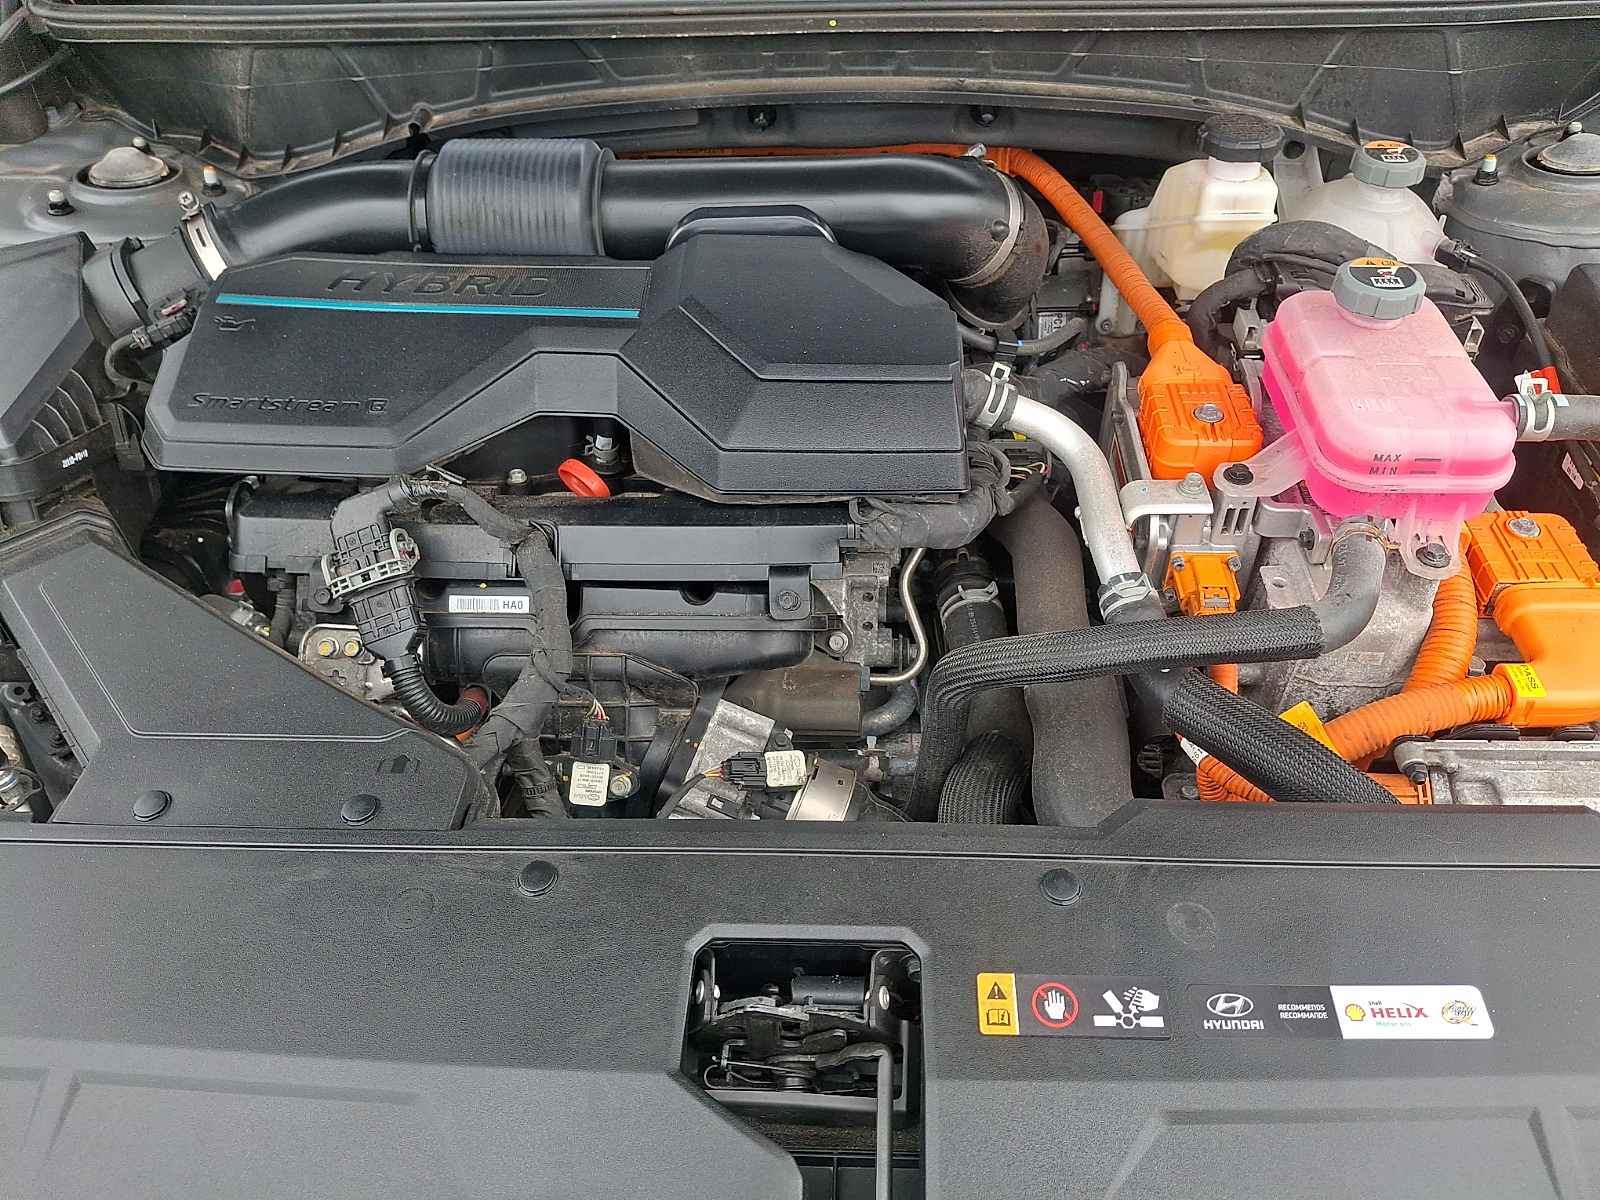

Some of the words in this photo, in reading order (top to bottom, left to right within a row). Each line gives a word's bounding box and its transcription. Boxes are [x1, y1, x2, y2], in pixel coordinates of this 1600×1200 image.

[326, 271, 555, 298] HYBRID
[188, 393, 361, 413] Smartstream
[1373, 453, 1402, 462] MAX
[1369, 466, 1398, 475] MIN
[1521, 664, 1539, 689] PASS
[1278, 1003, 1326, 1011] RECOMMENDS
[1370, 1006, 1430, 1018] HELIX
[1280, 1011, 1329, 1019] RECOMMANDE
[1203, 1019, 1265, 1030] HYUNDAI
